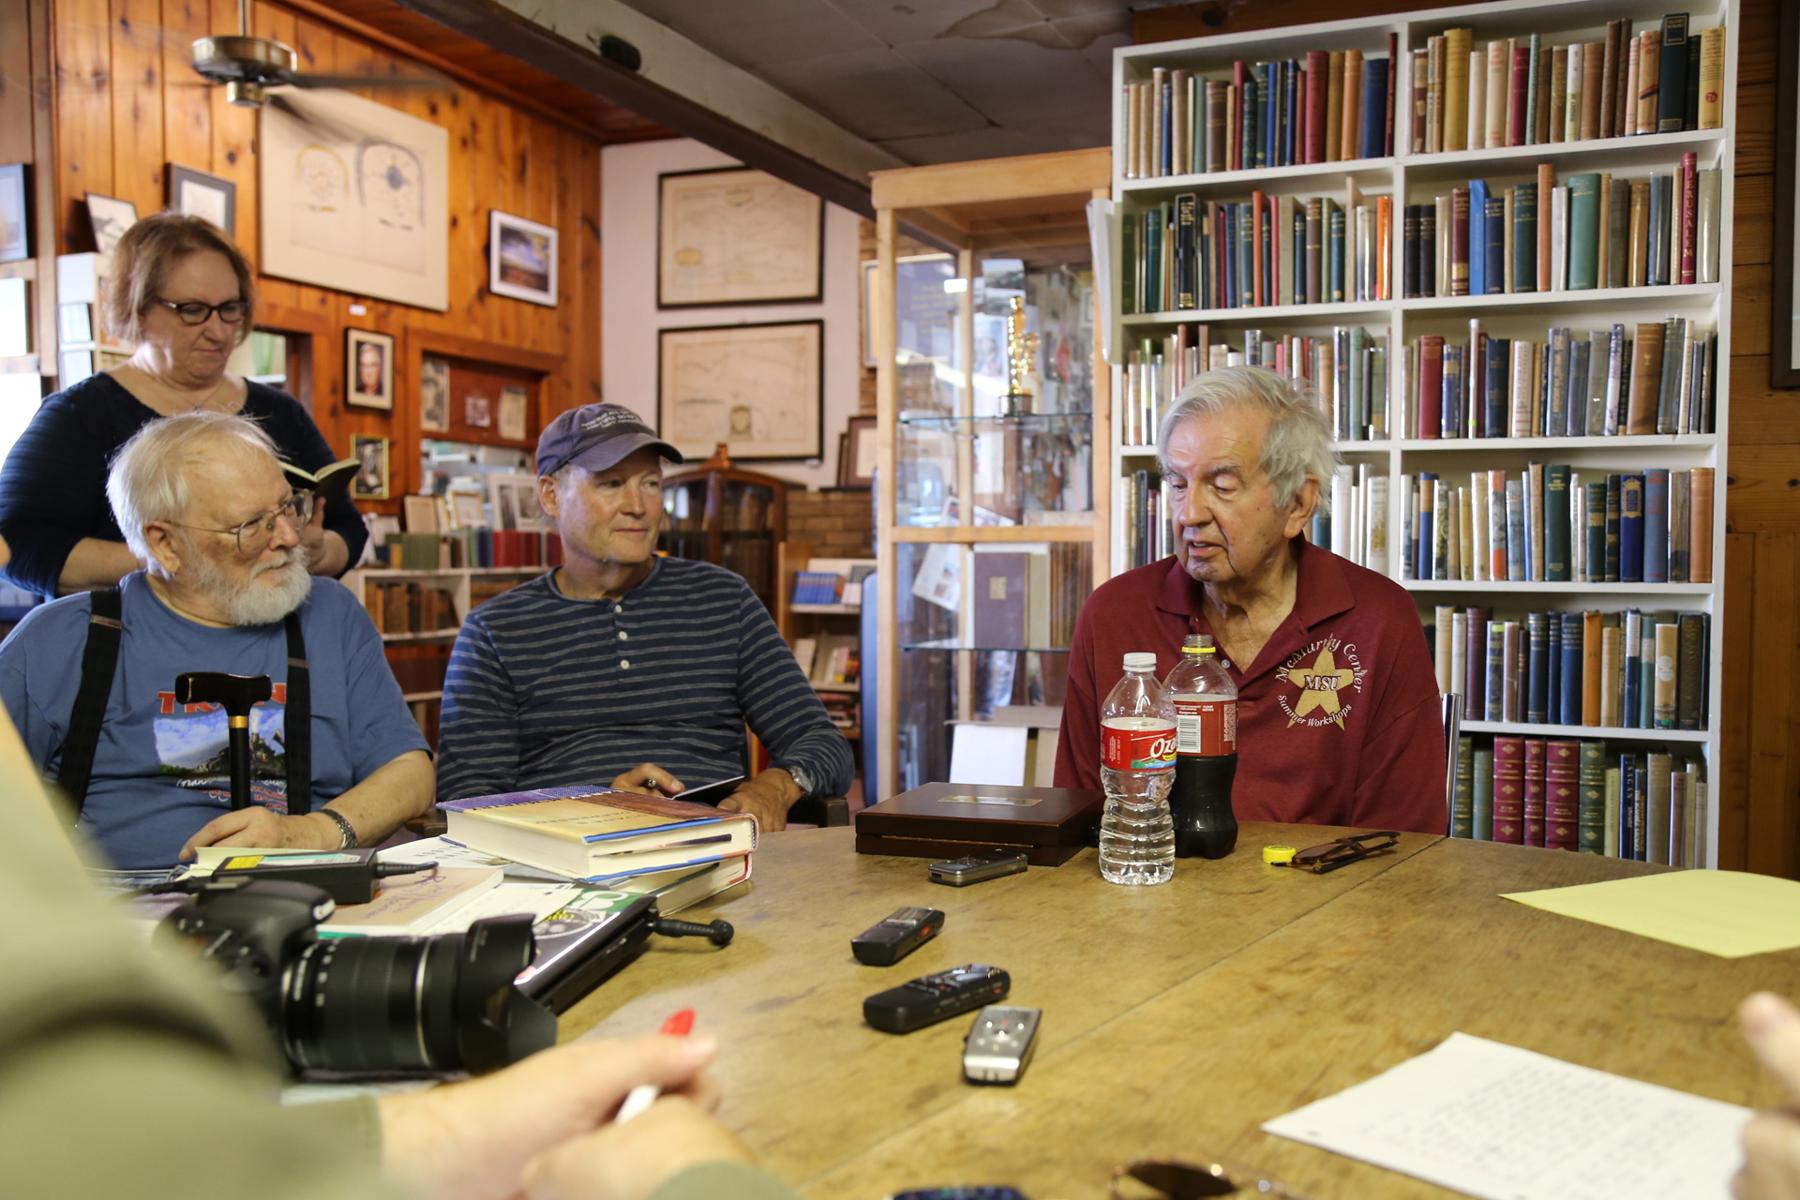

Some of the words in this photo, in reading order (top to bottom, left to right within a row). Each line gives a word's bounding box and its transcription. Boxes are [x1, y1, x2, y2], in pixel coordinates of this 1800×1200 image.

[1682, 170, 1695, 258] JERUSALEM
[1304, 675, 1341, 692] MSU
[1343, 643, 1368, 693] Center
[1278, 695, 1306, 724] Summer
[1308, 704, 1352, 727] Workshops
